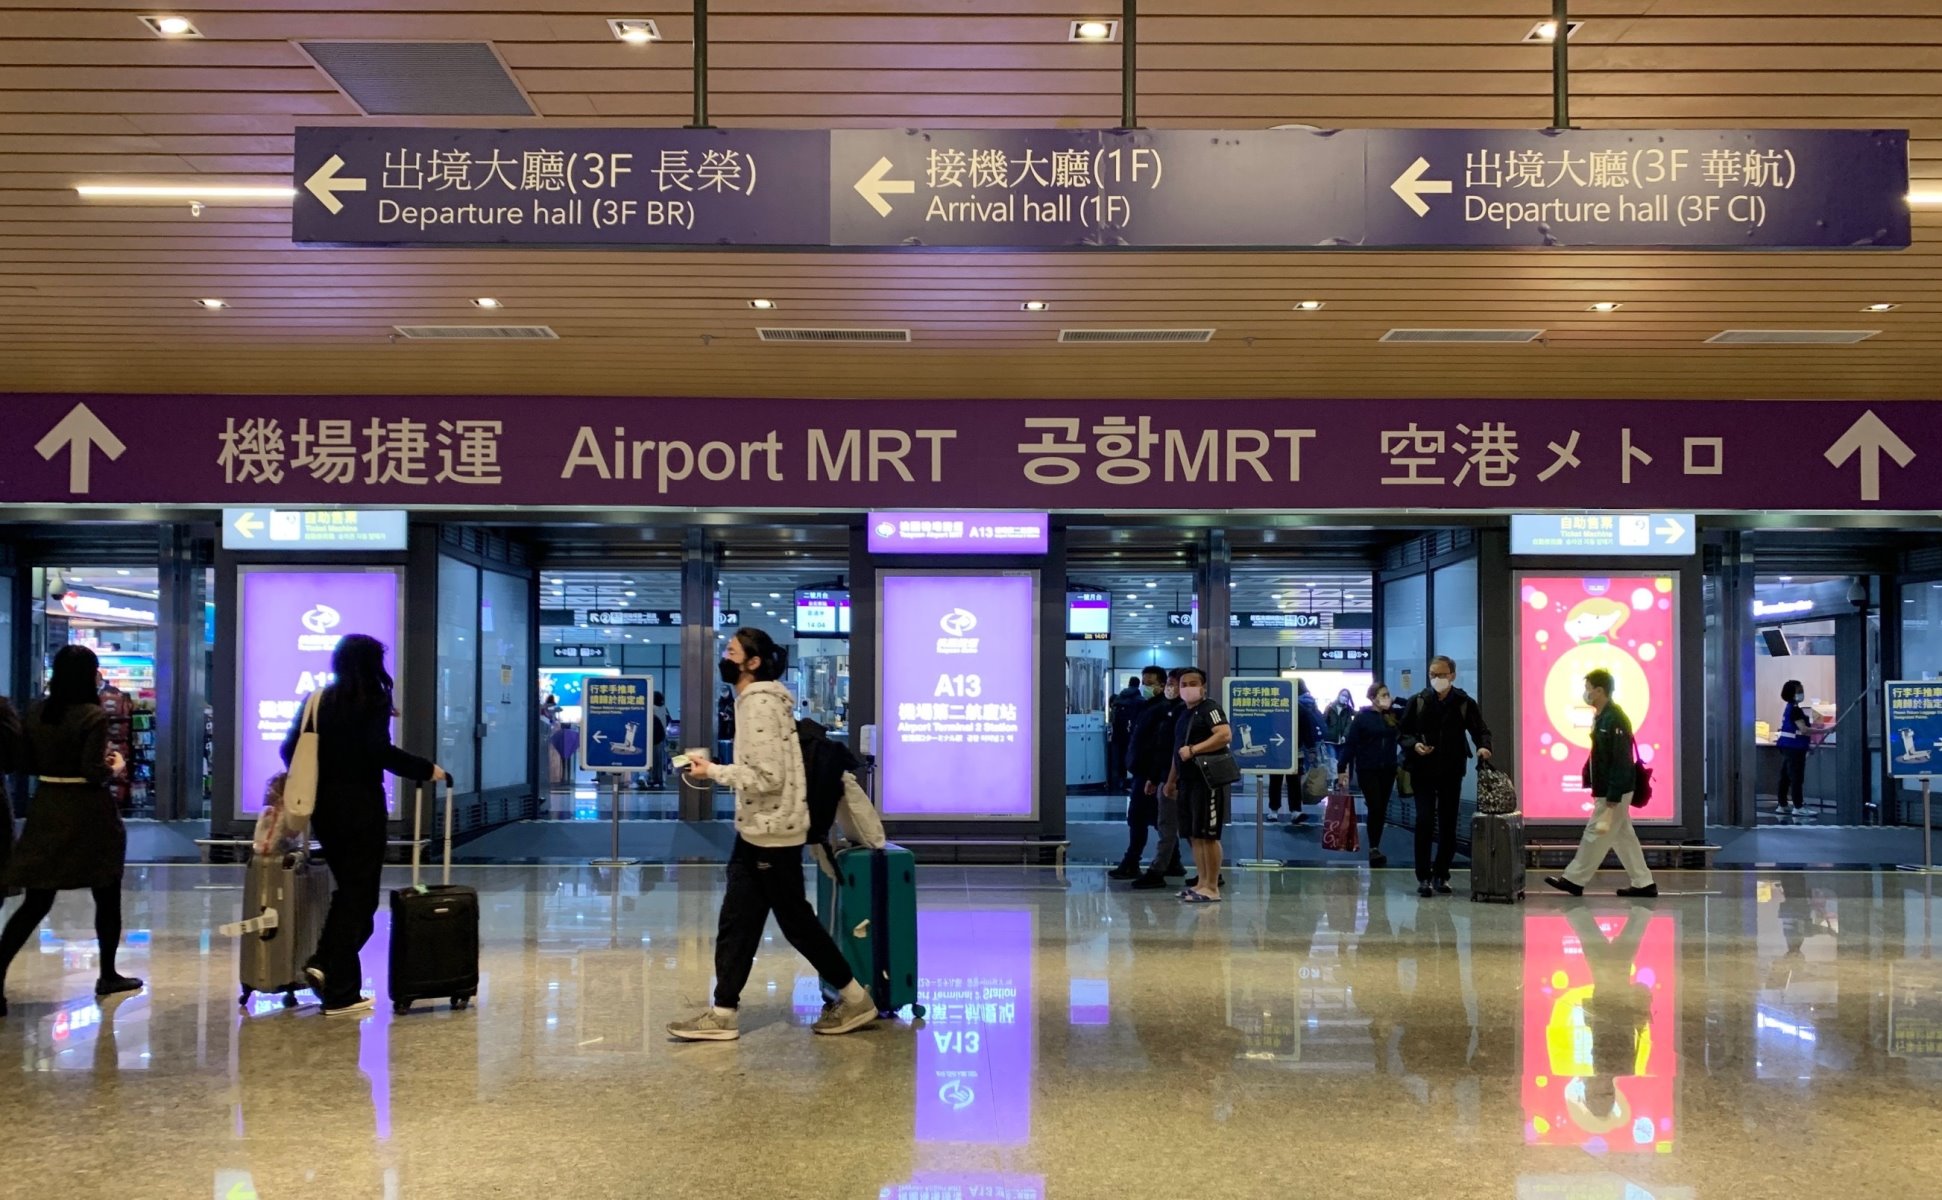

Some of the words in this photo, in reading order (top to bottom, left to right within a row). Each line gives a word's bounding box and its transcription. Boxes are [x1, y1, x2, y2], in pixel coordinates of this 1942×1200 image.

[382, 147, 633, 195] 出境大廳(3F
[650, 149, 757, 196] 長榮)
[925, 147, 1162, 190] 接機大廳(1F)
[1466, 148, 1689, 190] 出境大廳(3F
[1701, 148, 1797, 190] 華航)
[378, 199, 524, 231] Departure
[533, 198, 582, 225] hall
[592, 198, 638, 229] (3F
[647, 200, 695, 230] BR)
[925, 194, 1014, 222] Arrival
[1023, 193, 1071, 223] hall
[1080, 195, 1131, 228] (1F)
[1464, 195, 1611, 228] Departure
[1619, 194, 1668, 222] hall
[1677, 195, 1721, 227] (3F
[1727, 194, 1766, 227] CI)
[216, 416, 503, 485] 機場捷運
[560, 426, 784, 494] Airport
[807, 428, 957, 482] MRT
[1017, 415, 1317, 485] 공항MRT
[968, 526, 994, 539] A13
[934, 673, 982, 698] A13
